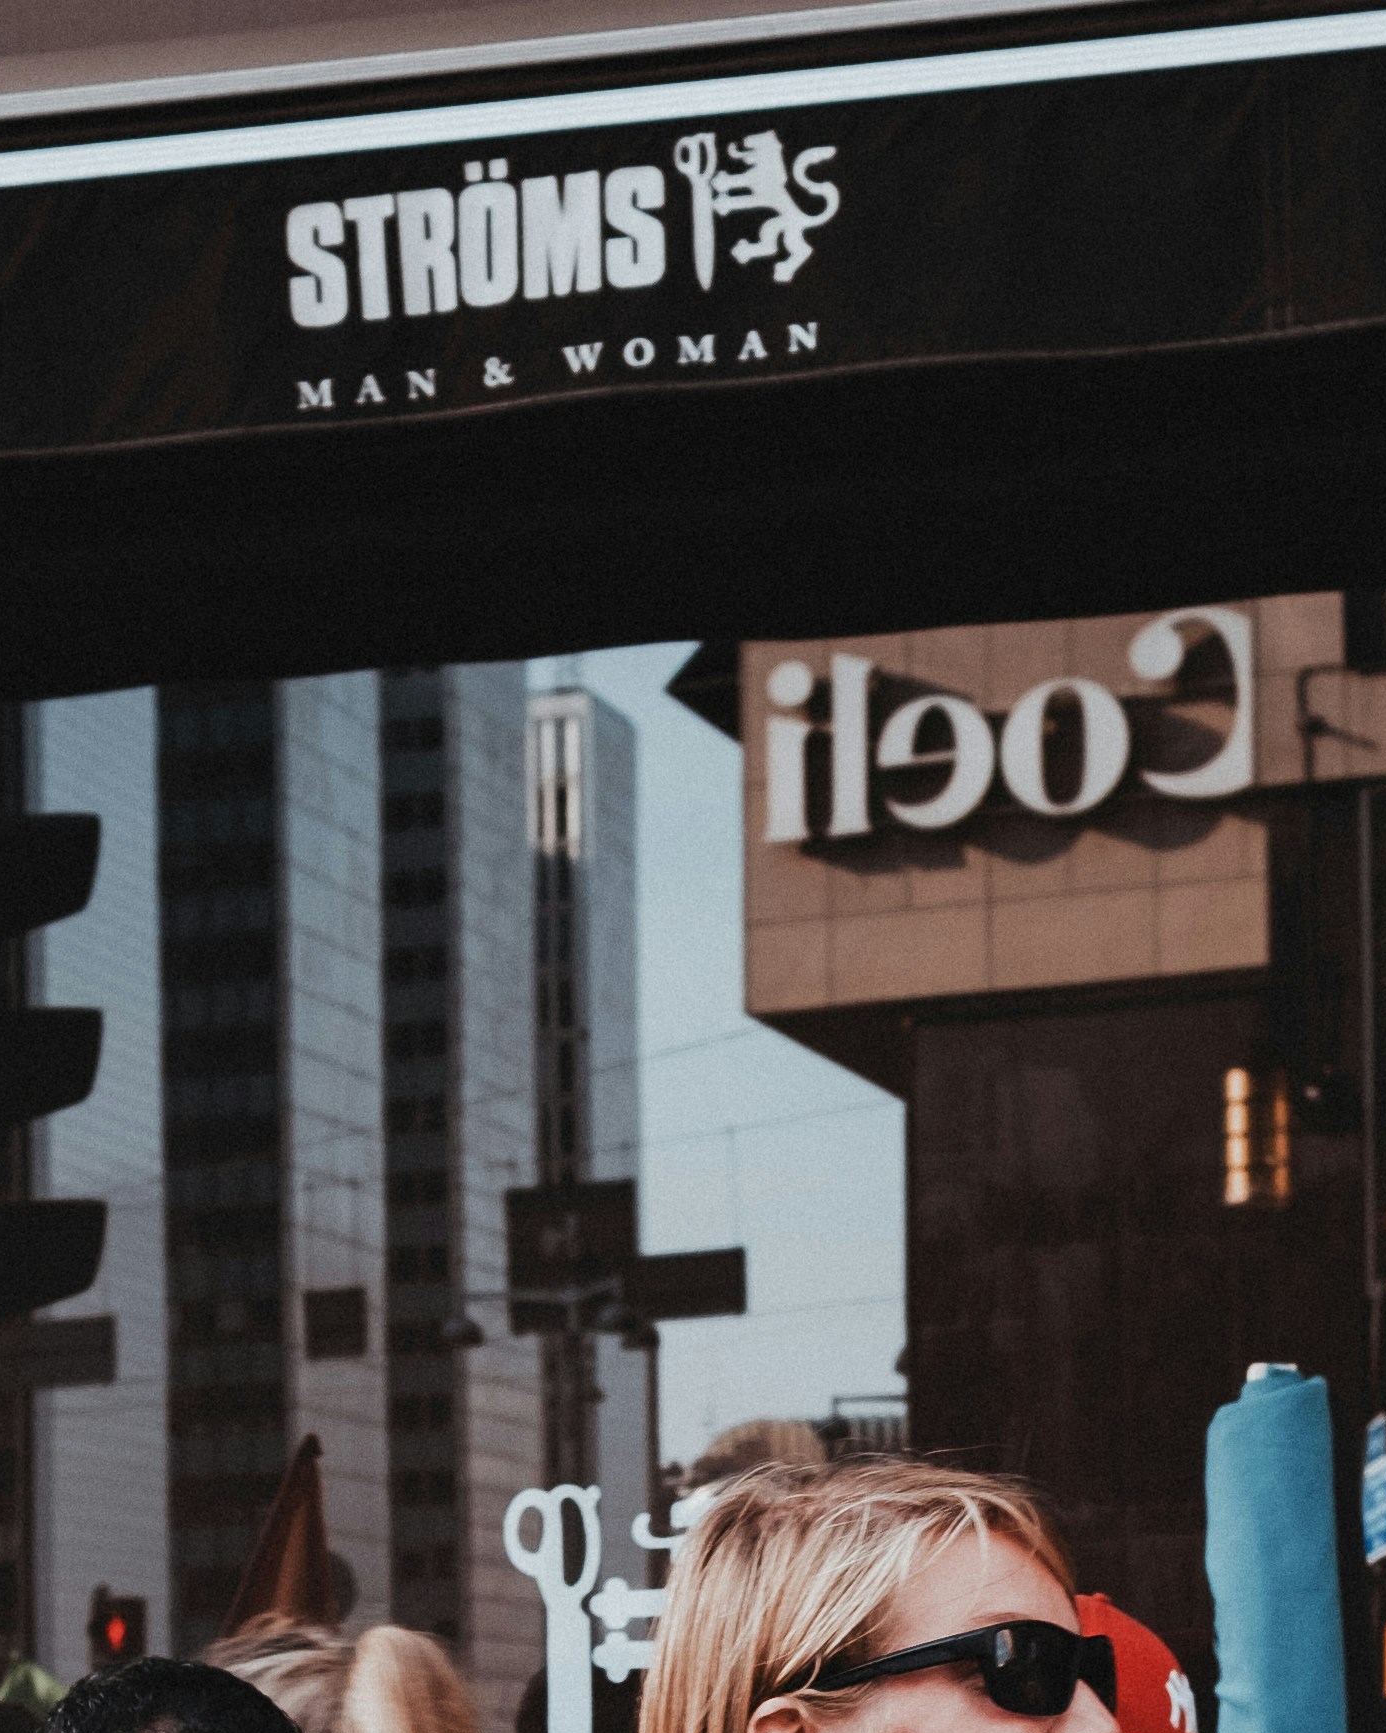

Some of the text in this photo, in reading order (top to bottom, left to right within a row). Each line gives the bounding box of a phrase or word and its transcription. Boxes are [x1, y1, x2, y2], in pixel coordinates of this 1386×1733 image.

[286, 157, 666, 328] STRÖMS
[297, 321, 819, 410] MAN & WOMAN
